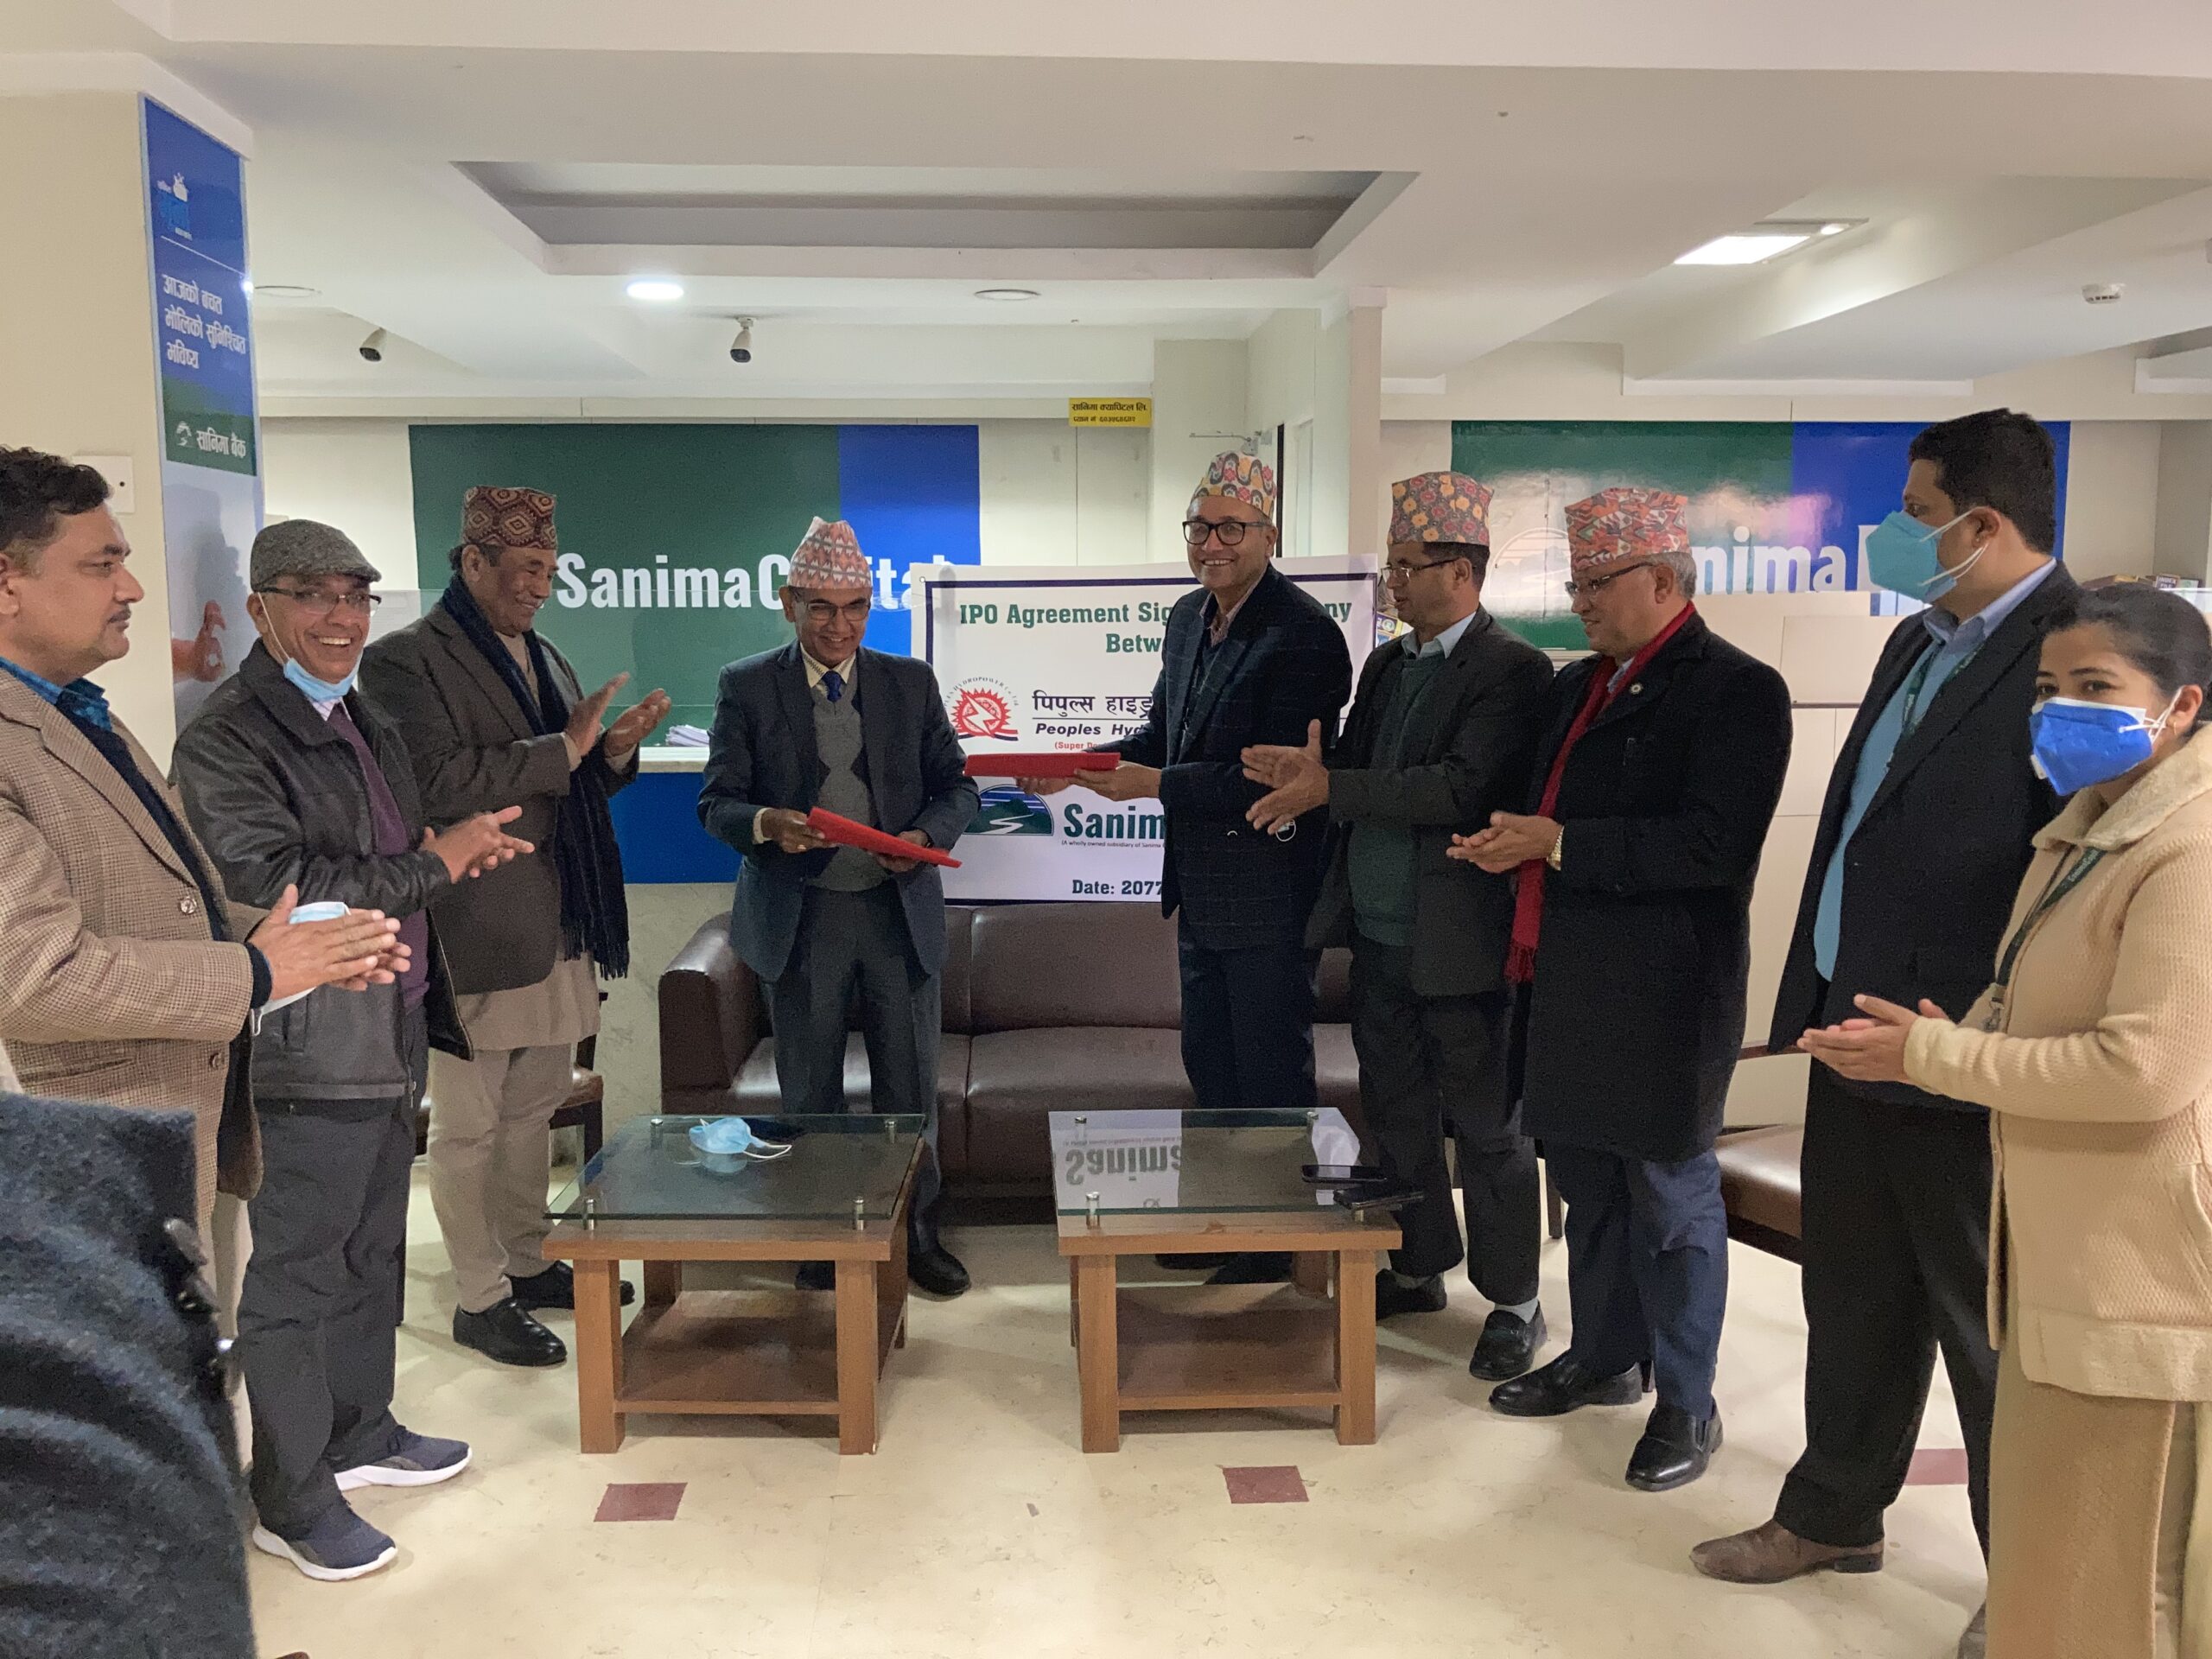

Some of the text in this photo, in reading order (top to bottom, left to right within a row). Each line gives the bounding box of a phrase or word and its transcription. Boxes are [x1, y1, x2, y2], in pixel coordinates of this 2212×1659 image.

[960, 604, 998, 624] IPO
[1007, 604, 1129, 628] Agreement
[1106, 633, 1163, 653] Betw
[1032, 690, 1096, 717] पिपुल्स
[1035, 723, 1102, 737] Peoples
[1054, 741, 1084, 750] (Super
[1064, 803, 1166, 840] Sanim
[1072, 880, 1115, 894] Date:
